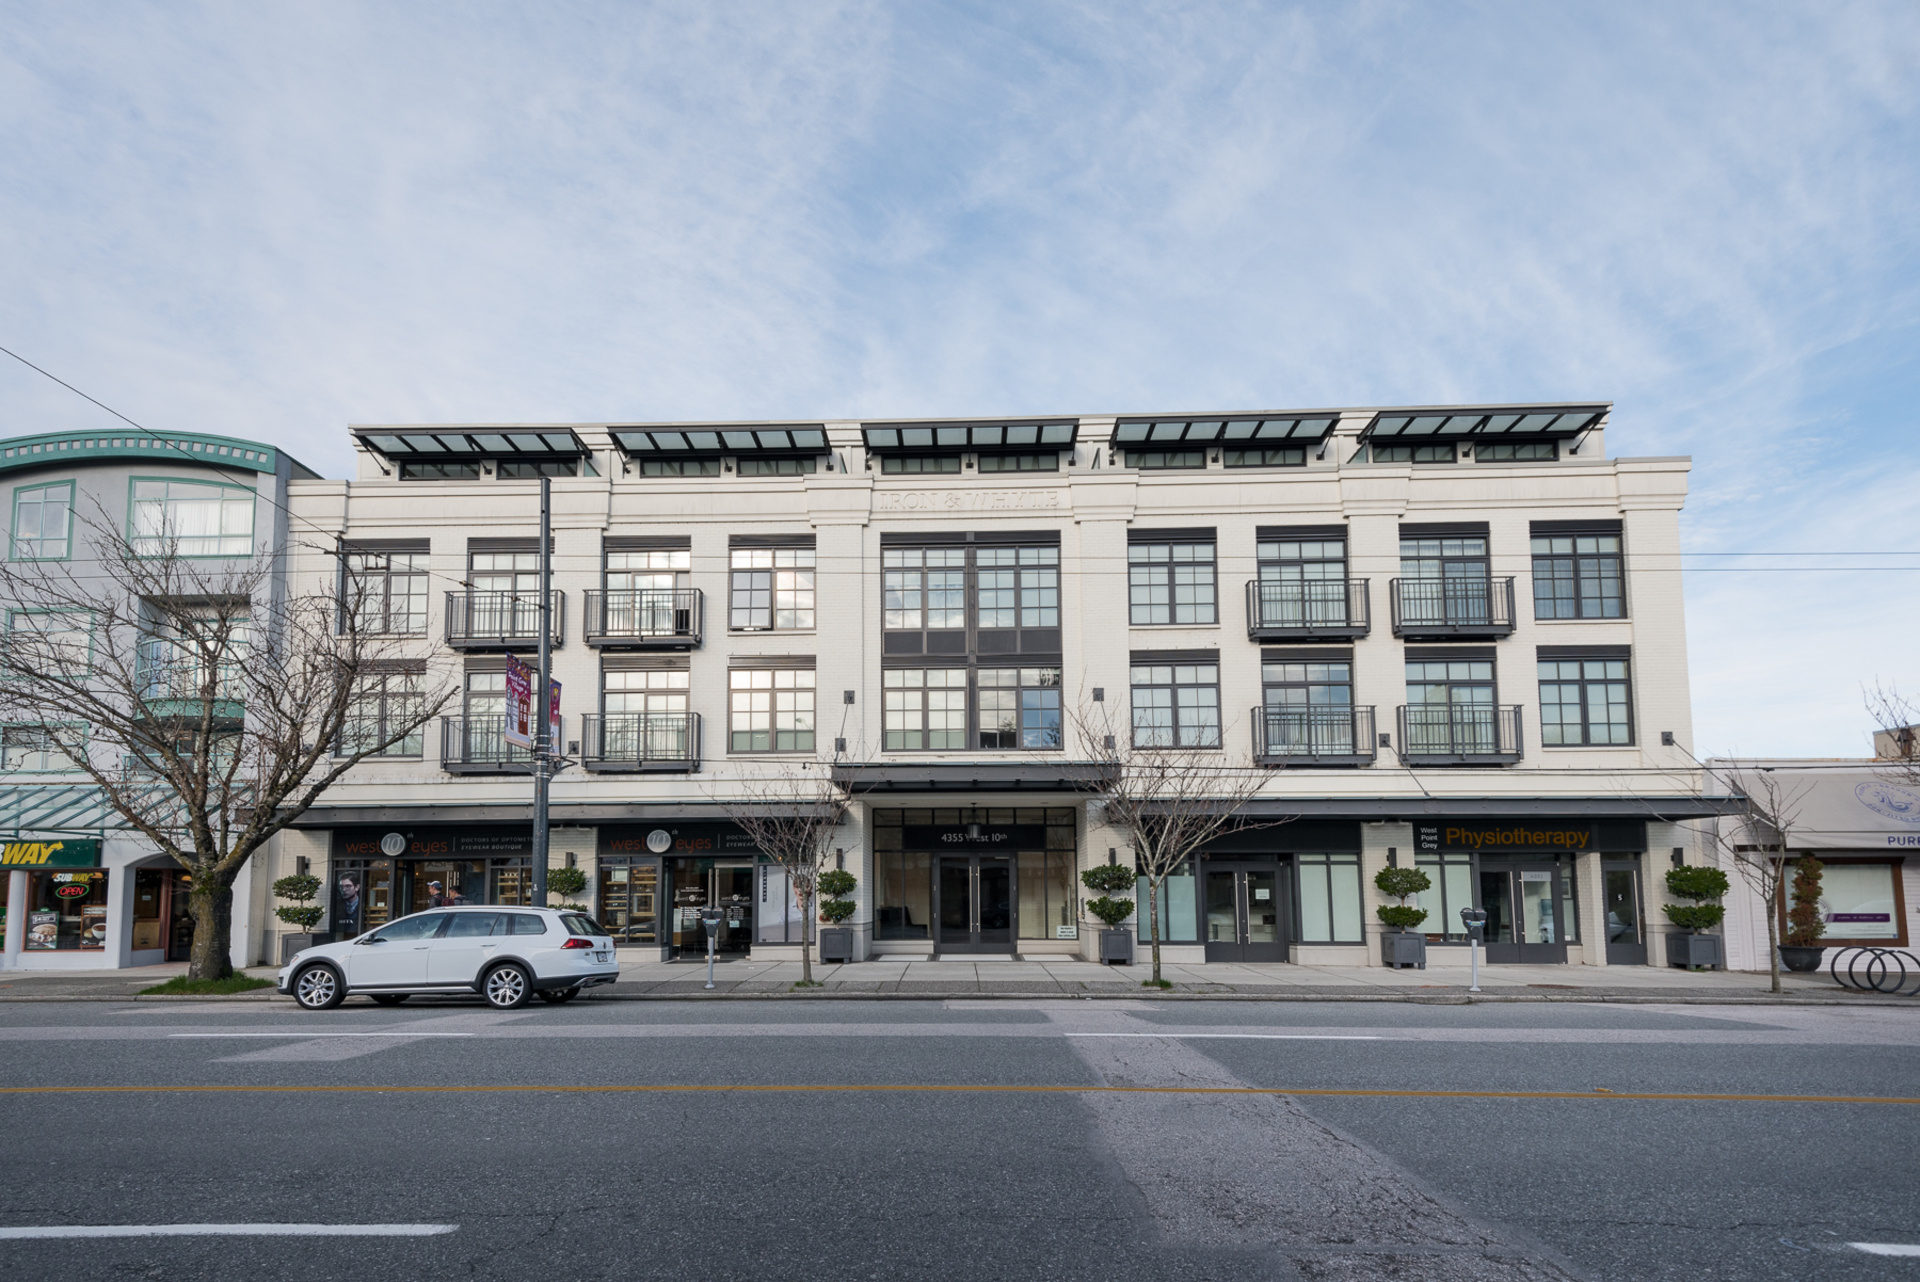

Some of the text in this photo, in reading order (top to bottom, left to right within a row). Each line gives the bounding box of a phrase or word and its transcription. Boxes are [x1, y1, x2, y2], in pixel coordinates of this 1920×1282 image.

[879, 491, 1060, 509] IRON & WHYTE
[941, 833, 964, 843] 4355
[991, 833, 1008, 842] 10th
[1446, 828, 1589, 849] Physiotherapy
[345, 840, 382, 854] west
[411, 841, 448, 857] eyes
[610, 836, 647, 851] west
[675, 838, 712, 854] eyes
[1421, 842, 1438, 850] Grey
[53, 873, 93, 882] SUBWAY
[59, 886, 84, 896] OPEN
